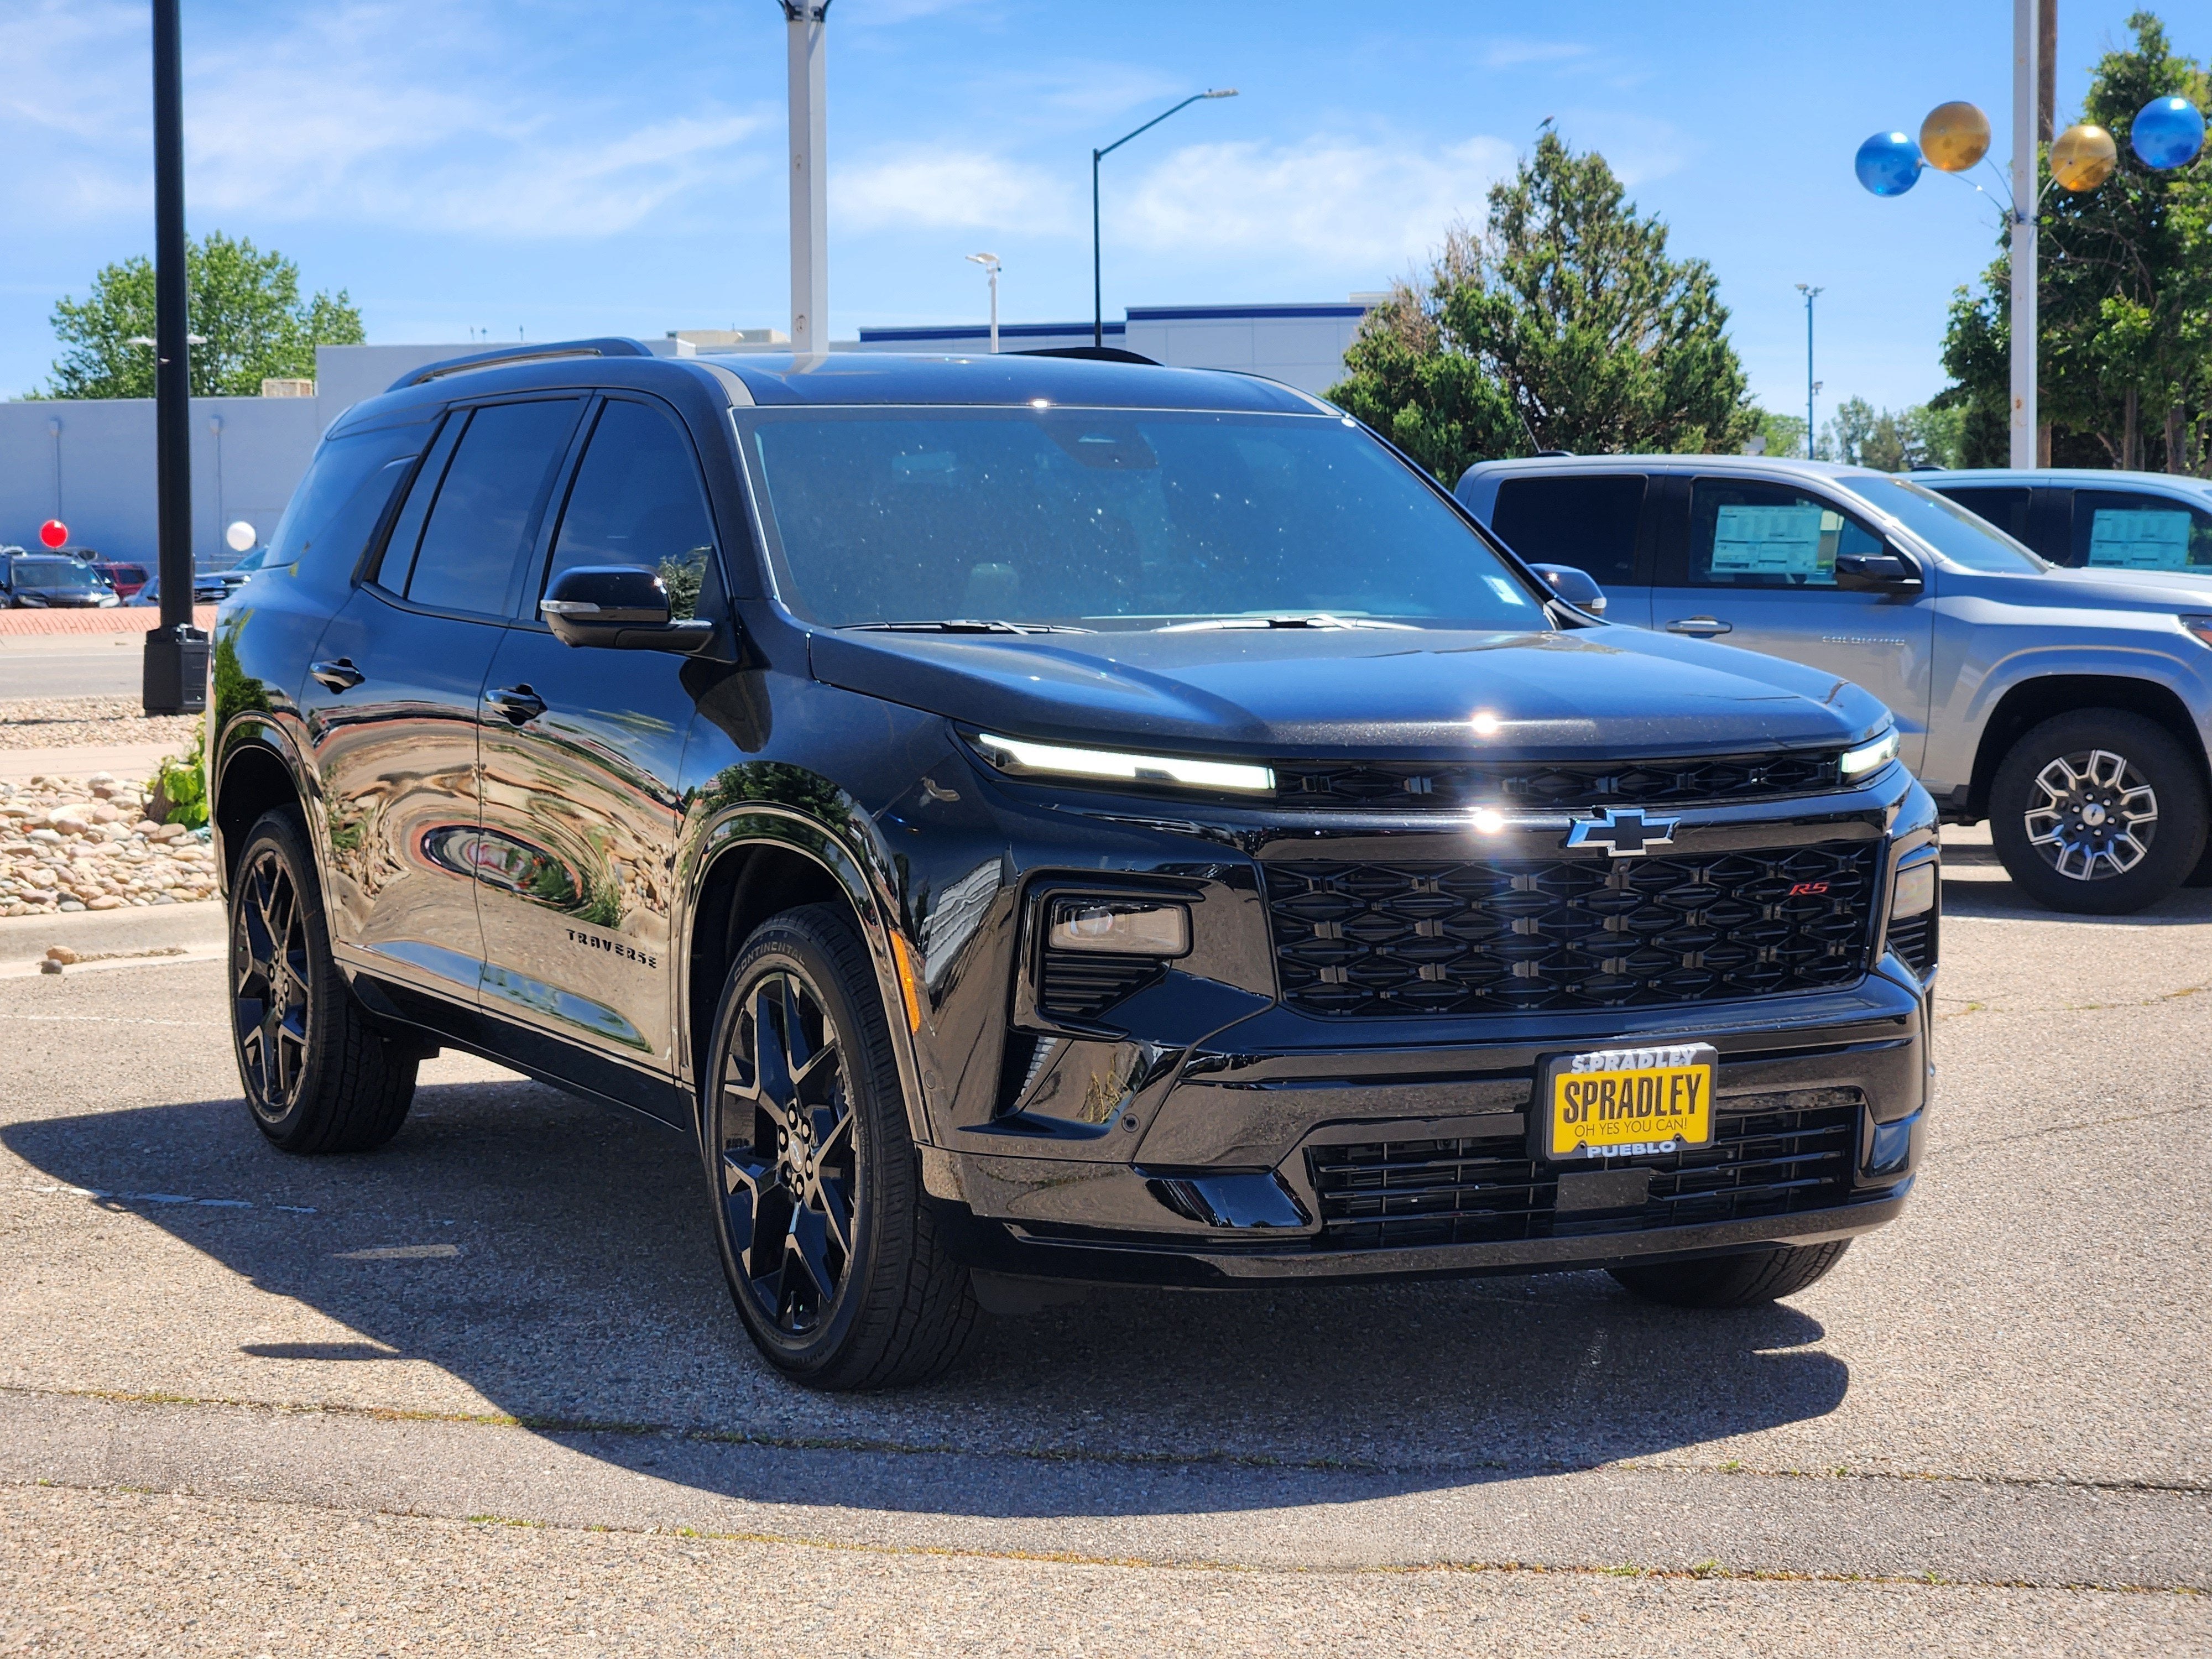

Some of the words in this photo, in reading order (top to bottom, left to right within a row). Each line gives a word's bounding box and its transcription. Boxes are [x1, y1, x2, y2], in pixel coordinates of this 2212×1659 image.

[1789, 881, 1829, 895] RS
[566, 928, 657, 968] TRAVERSE
[734, 941, 805, 982] CONTINENTAL
[1571, 1046, 1696, 1073] SPRADLEY
[1563, 1073, 1702, 1123] SPRADLEY
[1574, 1125, 1595, 1138] OH
[1600, 1123, 1620, 1135] YES
[1624, 1120, 1652, 1134] YOU
[1657, 1118, 1687, 1131] CAN!
[1587, 1140, 1677, 1159] PUEBLO
